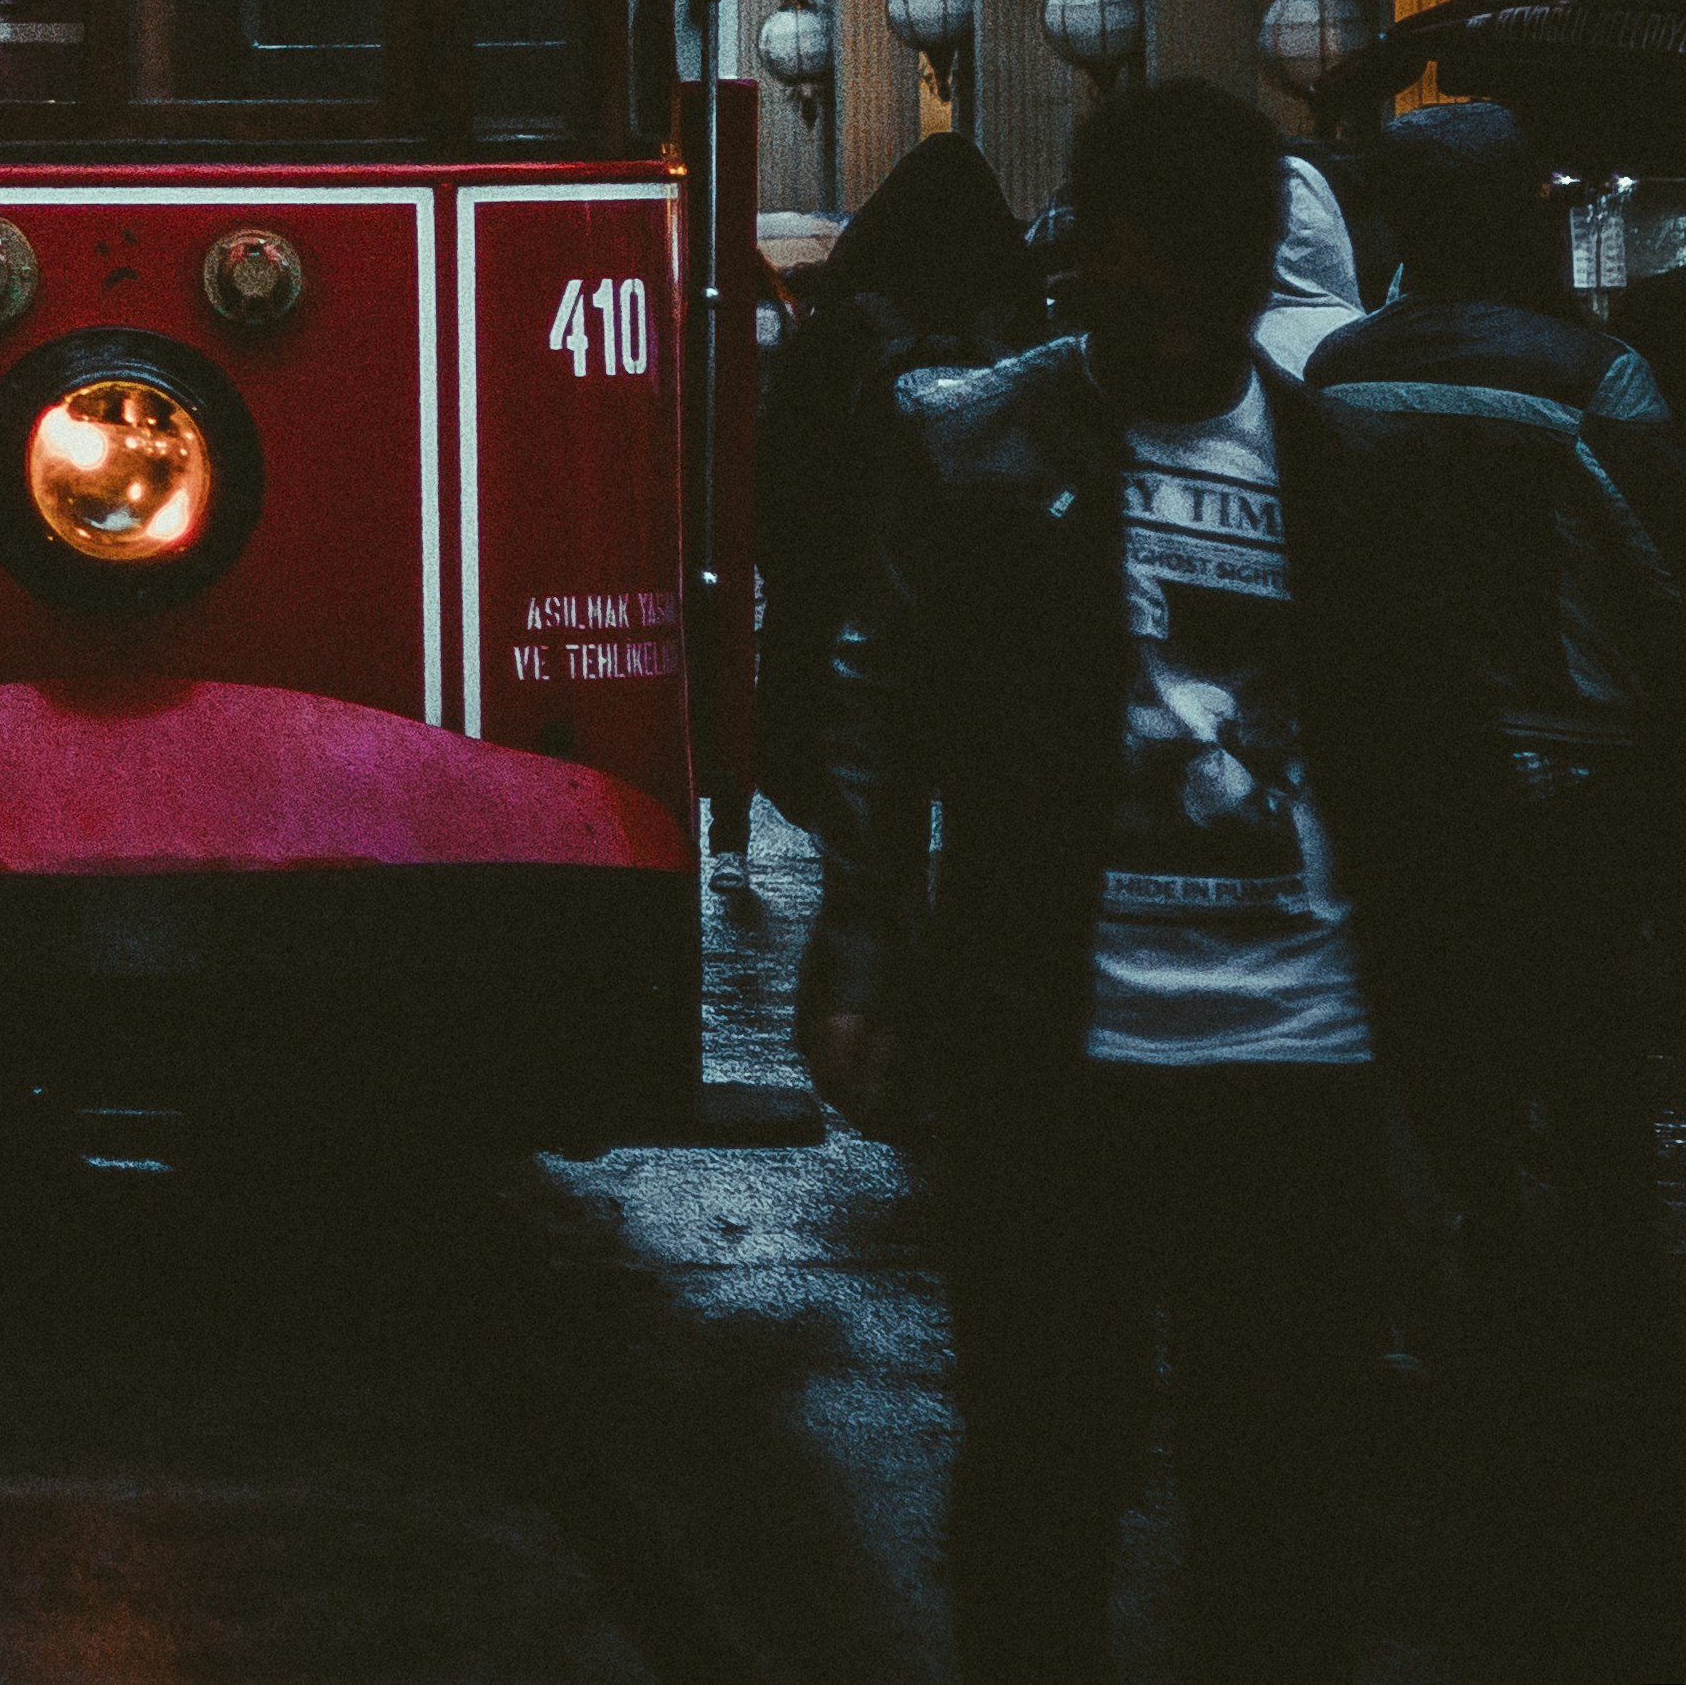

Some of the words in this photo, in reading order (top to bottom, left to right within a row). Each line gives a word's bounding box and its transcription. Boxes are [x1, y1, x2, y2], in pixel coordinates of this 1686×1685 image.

[548, 277, 648, 378] 410
[526, 594, 630, 631] ASILMAK
[513, 645, 551, 682] VE
